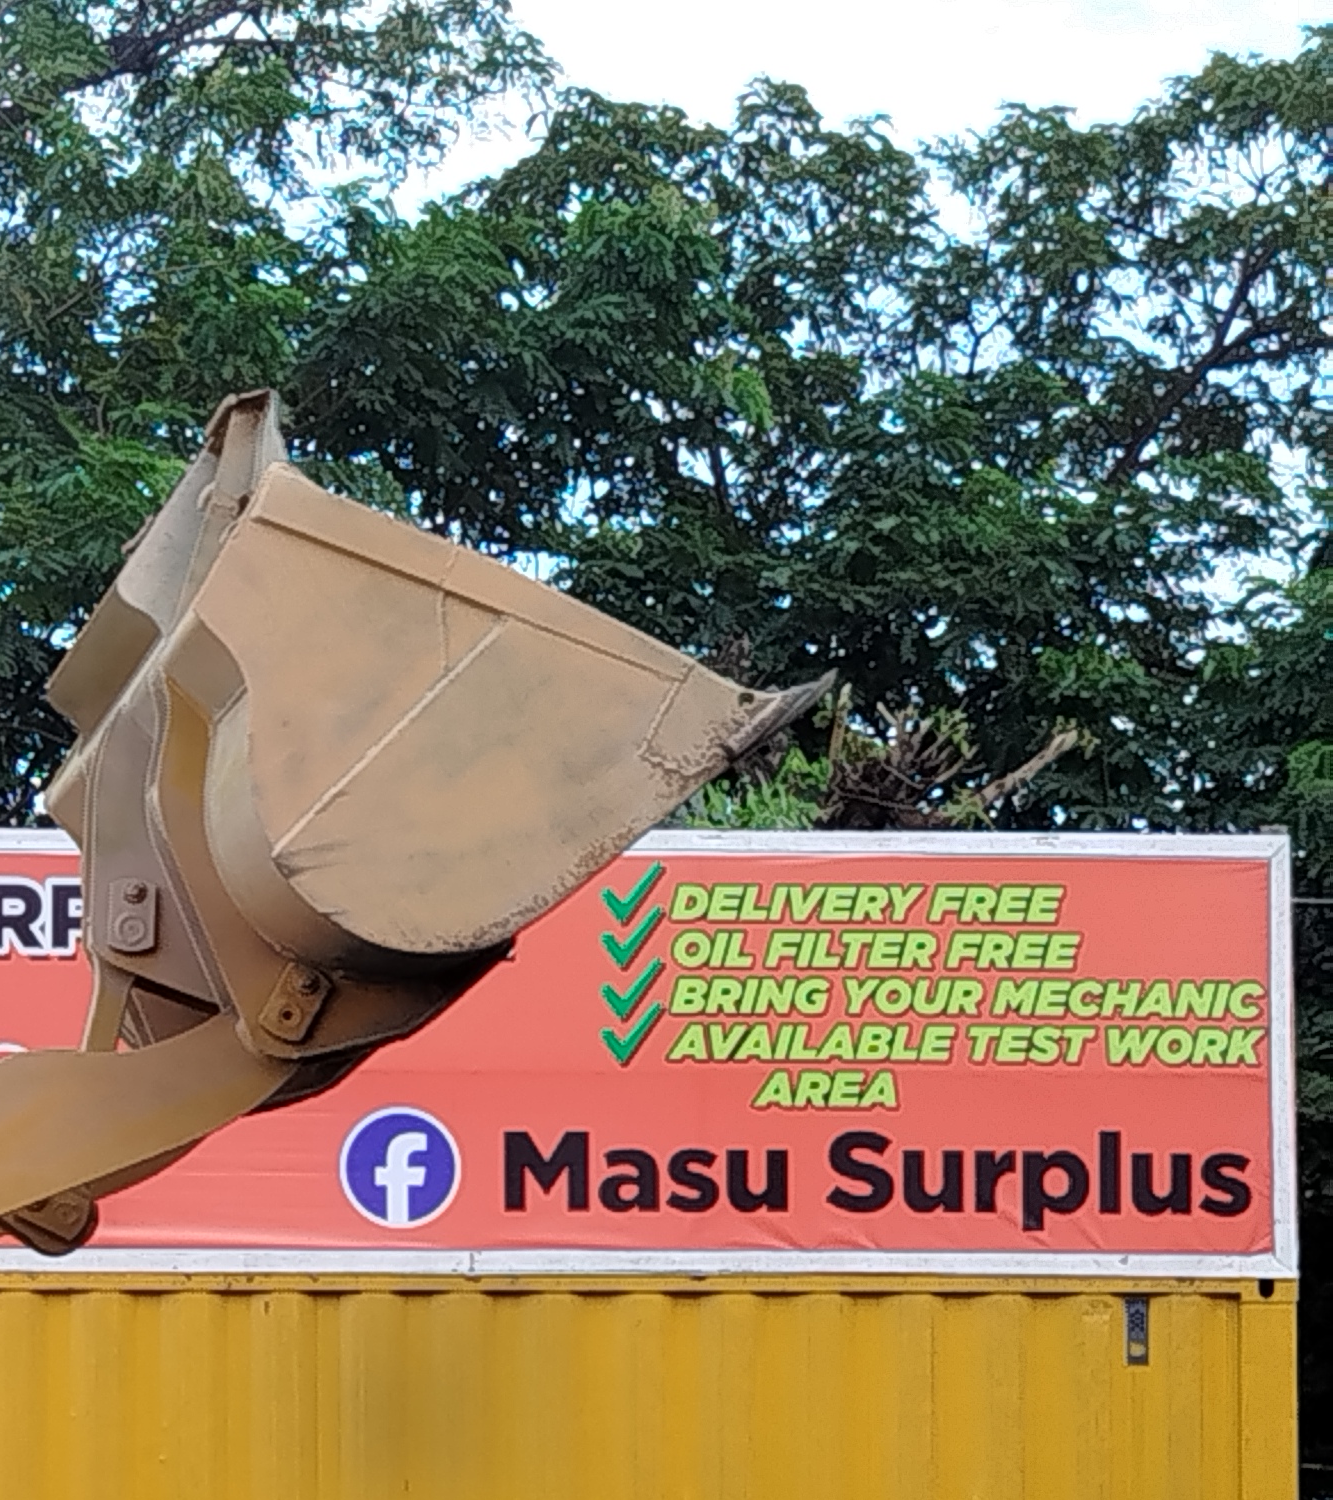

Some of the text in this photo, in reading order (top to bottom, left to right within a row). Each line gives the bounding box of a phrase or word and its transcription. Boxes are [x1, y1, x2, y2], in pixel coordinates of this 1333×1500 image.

[668, 883, 1066, 925] DELIVERY FREE
[671, 930, 1083, 971] OIL FILTER FREE
[668, 976, 1266, 1021] BRING YOUR MECHANIC
[665, 1022, 1267, 1067] AVAILABLE TEST WORK
[750, 1068, 899, 1109] AREA
[503, 1130, 1252, 1232] Masu Surplus
